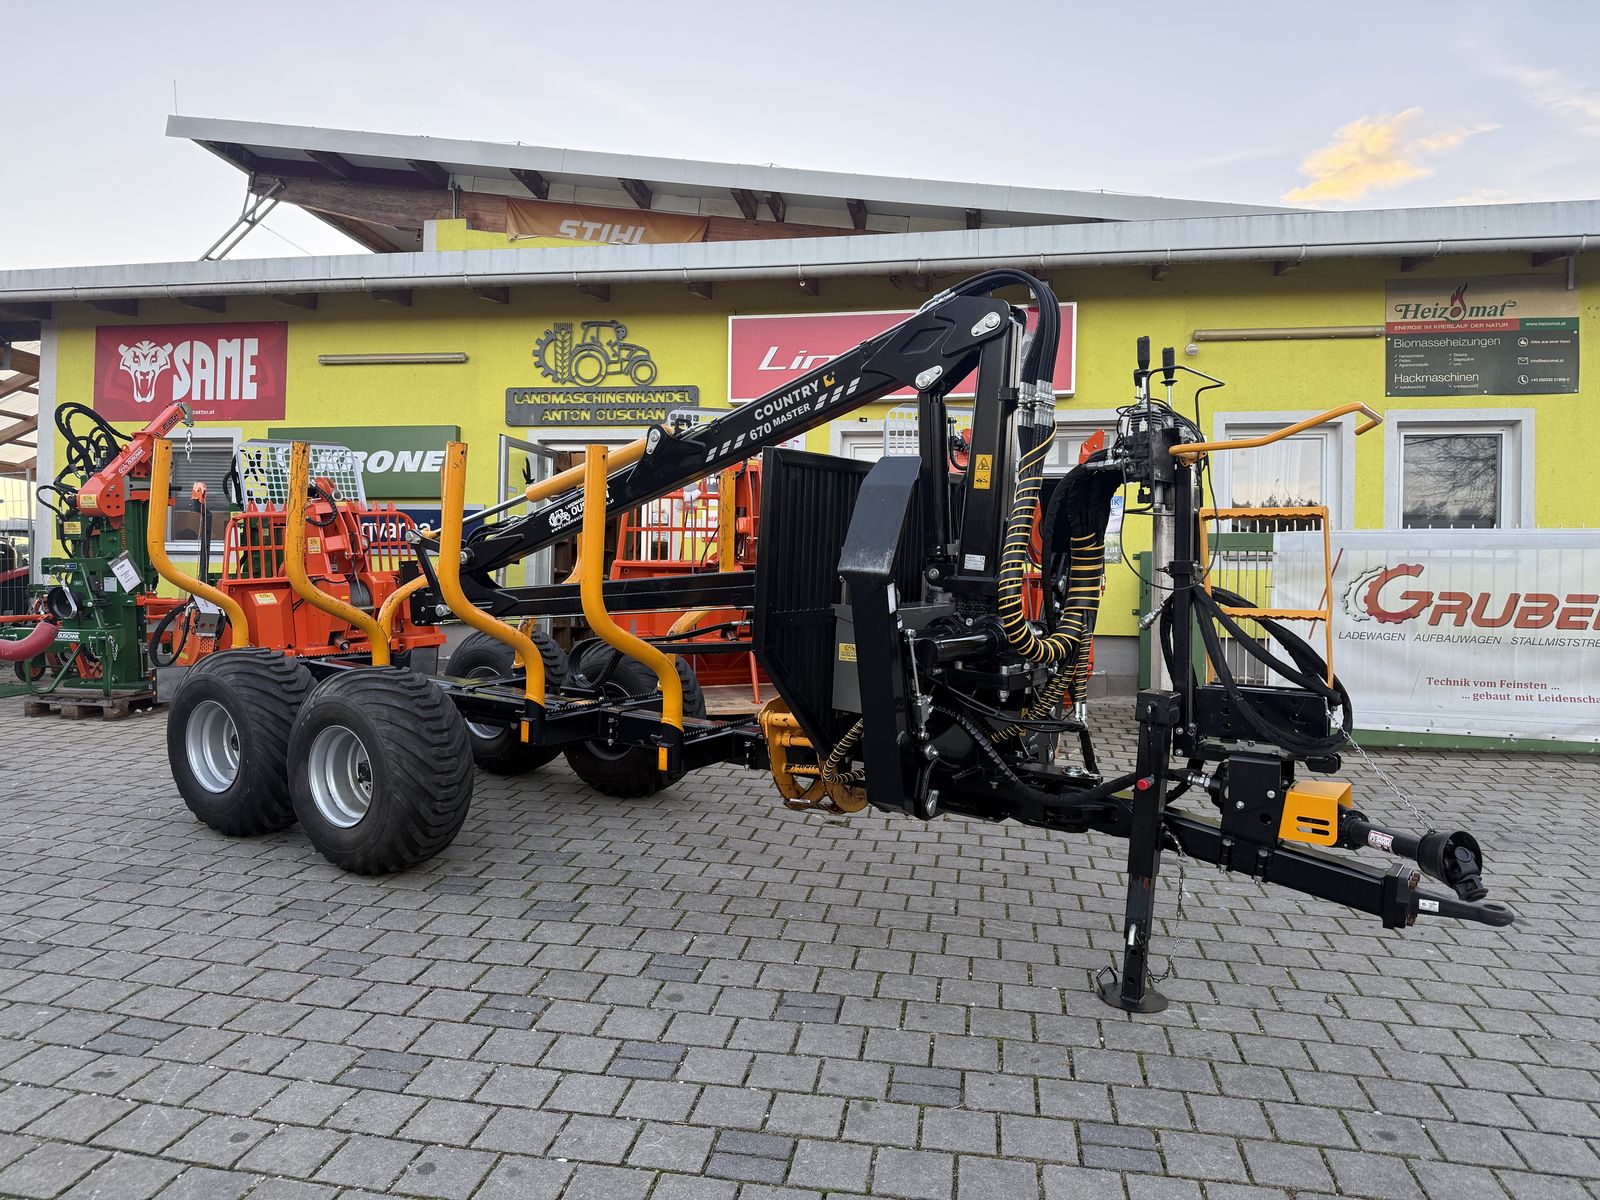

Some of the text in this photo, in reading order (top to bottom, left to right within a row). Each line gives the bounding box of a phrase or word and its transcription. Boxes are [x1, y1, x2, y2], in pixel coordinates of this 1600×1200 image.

[1393, 337, 1501, 349] Biomasseheizungen
[172, 338, 259, 400] SAME
[1394, 372, 1479, 383] Hackmaschinen
[513, 390, 693, 405] LANDMASCHINENHANDEL
[754, 379, 819, 421] COUNTRY
[541, 408, 666, 421] ANTON OUSCHAN
[749, 402, 811, 441] 670 MASTER
[1363, 563, 1600, 631] GRUBE
[1338, 631, 1406, 642] LADEWAGEN
[1413, 633, 1502, 645] AUFBAUWAGEN
[1426, 677, 1471, 687] Technik
[1499, 679, 1547, 690] Feinsten
[1472, 692, 1512, 702] gebaut
[1514, 692, 1534, 702] mit
